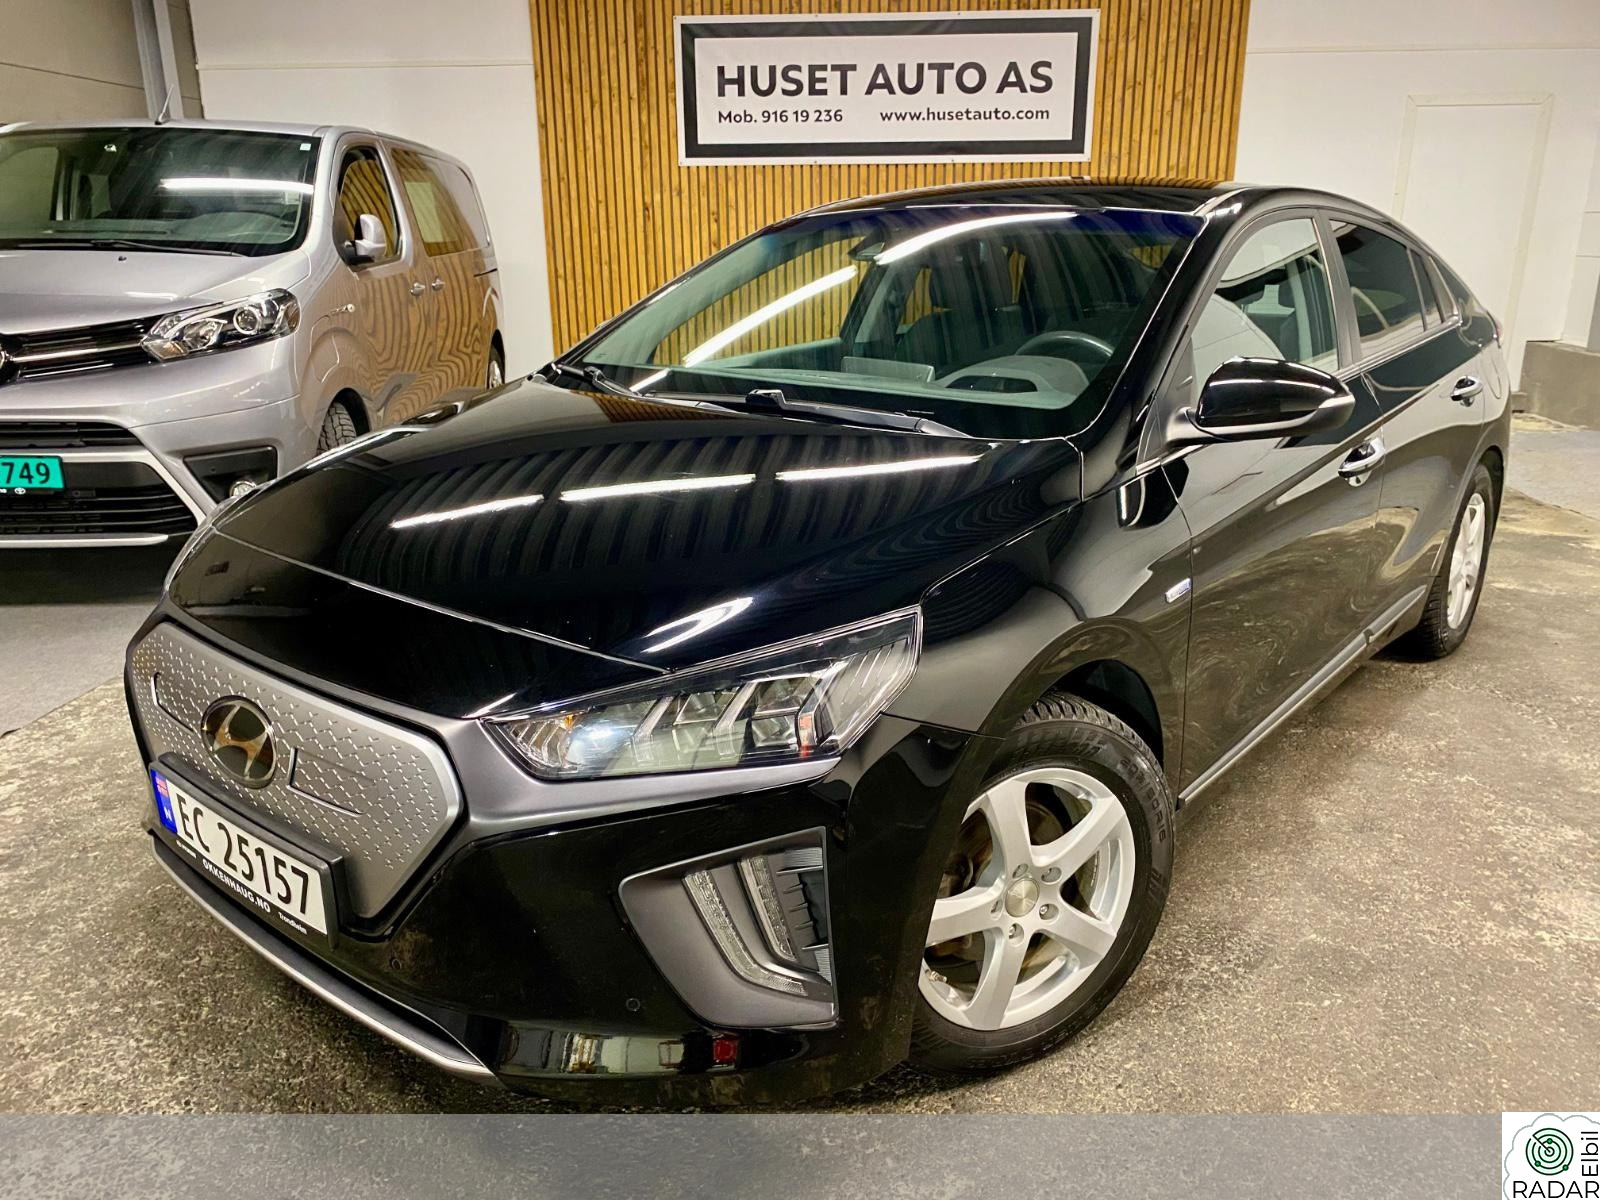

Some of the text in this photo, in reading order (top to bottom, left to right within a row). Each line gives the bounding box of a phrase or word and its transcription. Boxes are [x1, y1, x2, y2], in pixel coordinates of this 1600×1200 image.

[717, 60, 1054, 97] HUSET AUTO AS
[717, 107, 1051, 124] Mob. 916 19 236 www.husetauto.com
[176, 793, 308, 914] EC 25157
